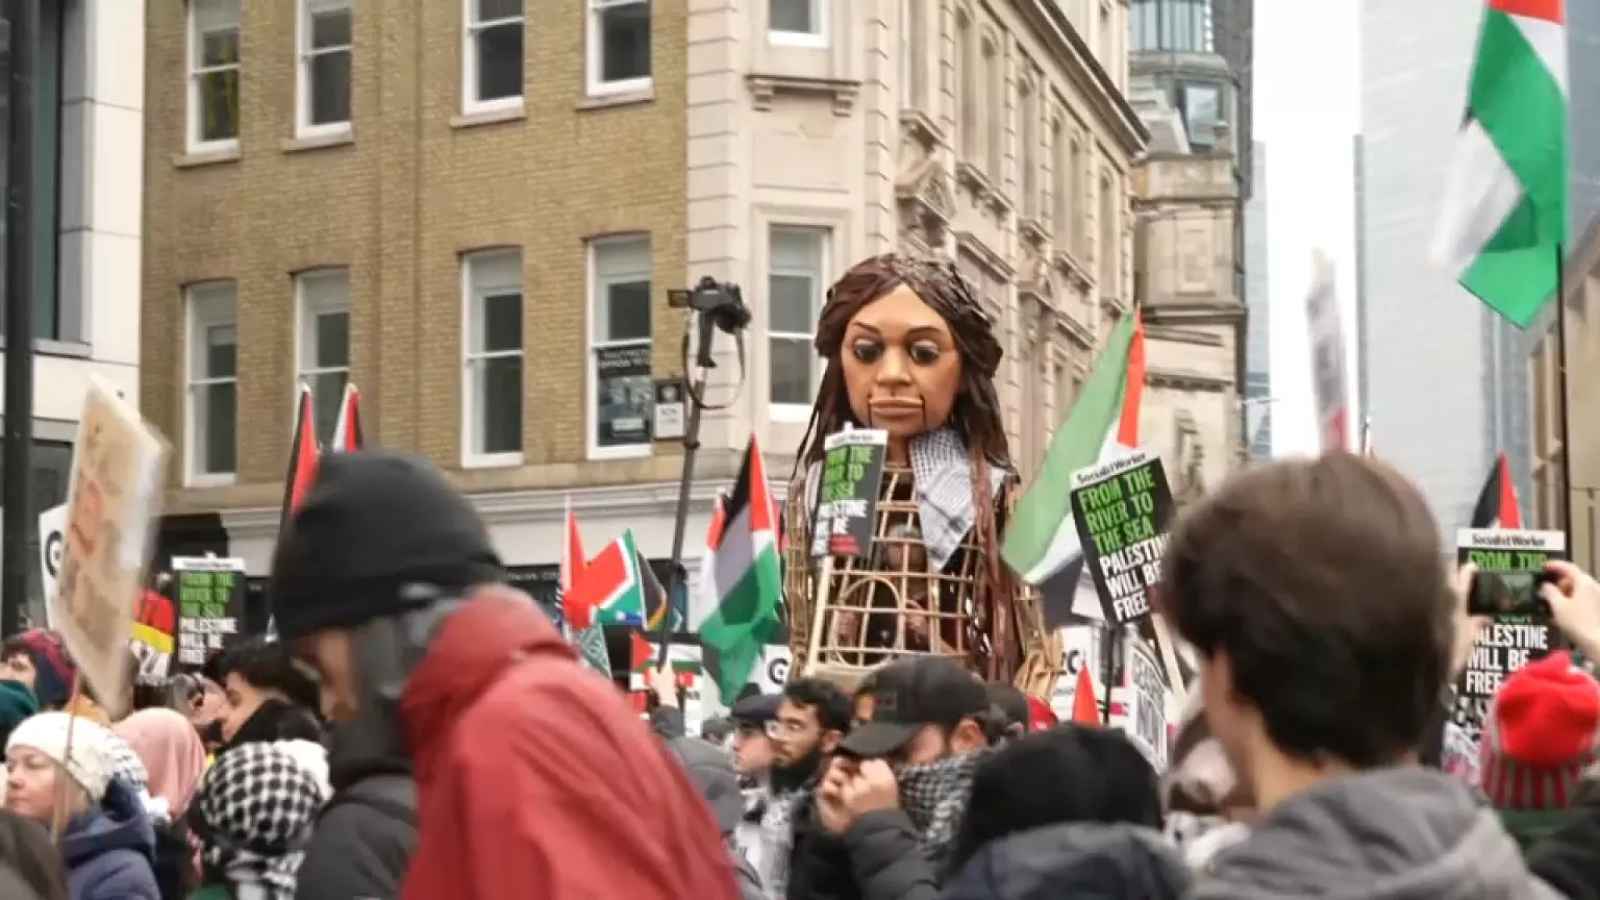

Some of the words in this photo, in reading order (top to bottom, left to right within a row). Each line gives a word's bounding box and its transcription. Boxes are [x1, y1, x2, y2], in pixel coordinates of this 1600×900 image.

[1078, 477, 1122, 512] FROM
[1127, 466, 1153, 495] THE
[1086, 500, 1129, 535] RIVER
[1130, 490, 1153, 515] TO
[1092, 528, 1123, 554] THE
[1123, 516, 1154, 543] SEA
[1106, 569, 1144, 599] WILL
[1113, 591, 1150, 622] FREE
